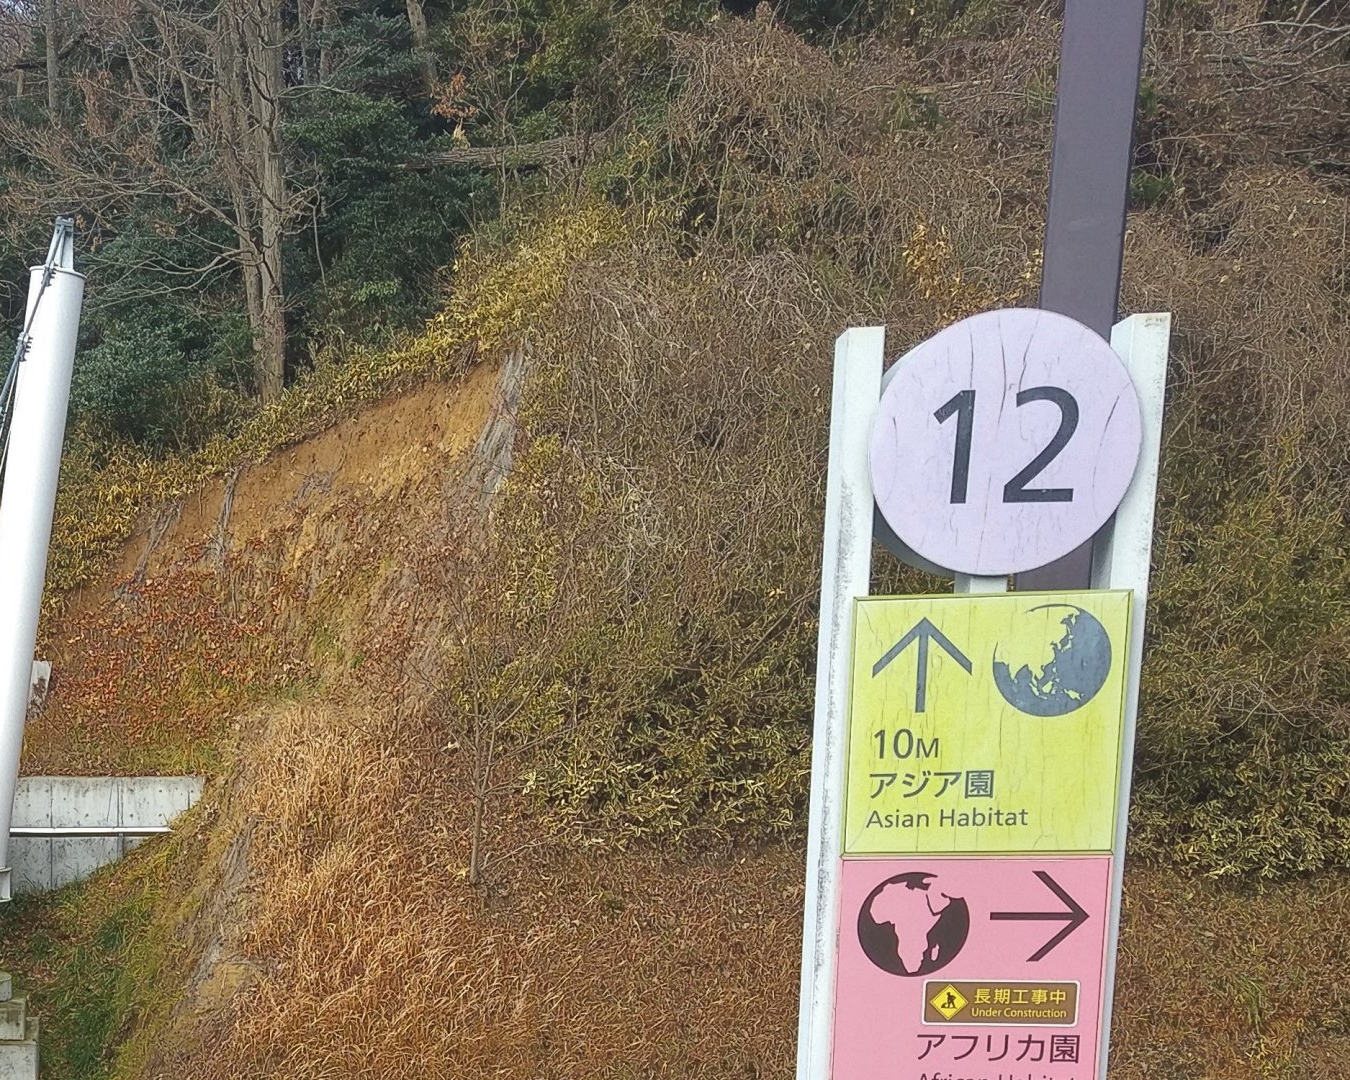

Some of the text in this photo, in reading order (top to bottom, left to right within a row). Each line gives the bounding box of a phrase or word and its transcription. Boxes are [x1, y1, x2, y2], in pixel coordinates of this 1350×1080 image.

[933, 386, 1079, 504] 12
[869, 769, 995, 799] アジア園
[866, 807, 1029, 828] Asian Habitat
[973, 988, 1067, 1005] 長期工事中
[971, 1007, 1067, 1018] Under Construction
[916, 1034, 1081, 1064] アフリカ園
